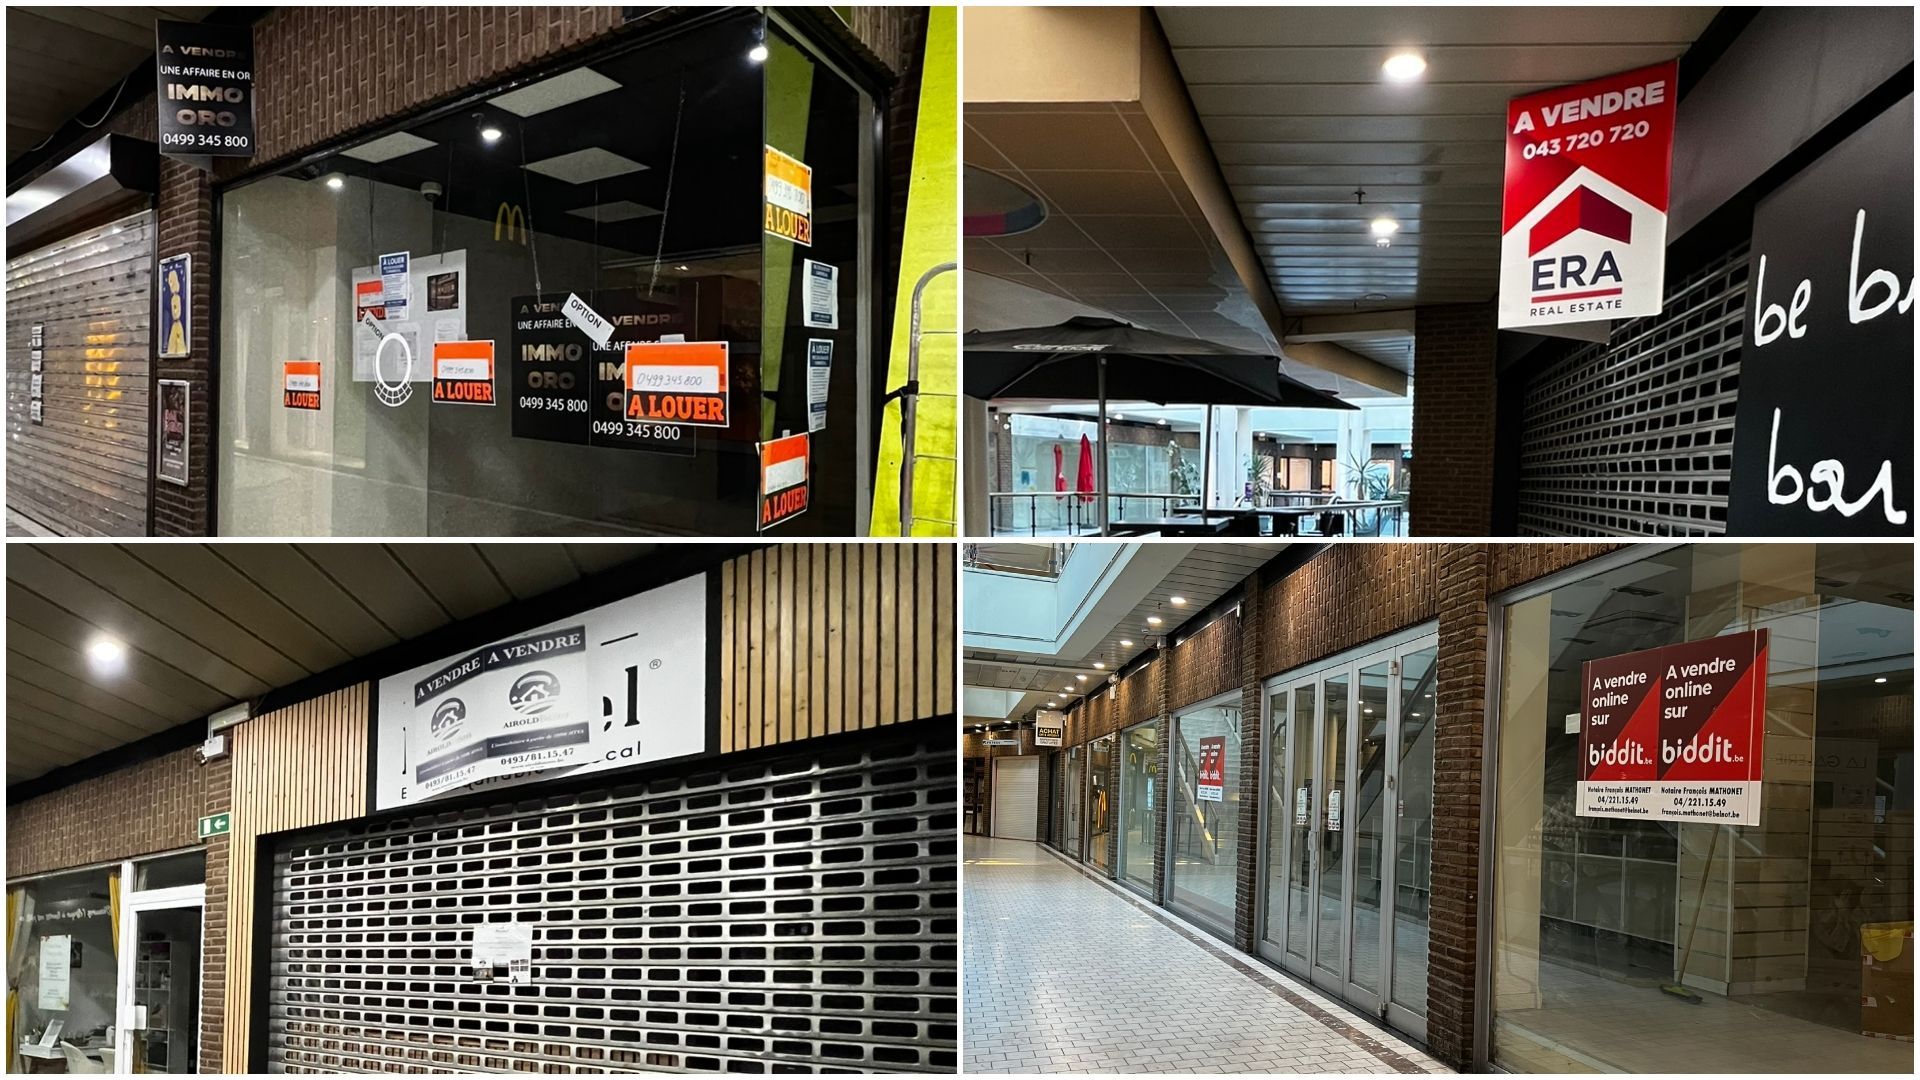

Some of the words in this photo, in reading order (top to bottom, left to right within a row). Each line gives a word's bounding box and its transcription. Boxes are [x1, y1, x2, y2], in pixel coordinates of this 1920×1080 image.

[162, 45, 174, 54] A
[179, 46, 240, 58] VENDR
[160, 65, 181, 76] UNE
[182, 67, 221, 78] AFFAIRE
[222, 69, 235, 79] EN
[236, 71, 251, 81] OR
[167, 83, 244, 104] IMMO
[1512, 111, 1535, 134] A
[1541, 80, 1666, 127] VENDRE
[176, 109, 237, 127] ORO
[162, 133, 195, 145] 0499
[197, 134, 222, 147] 345
[224, 135, 249, 148] 800
[1522, 138, 1561, 160] 043
[1566, 130, 1604, 152] 720
[1609, 121, 1650, 143] 720
[765, 204, 775, 231] A
[775, 207, 811, 244] LOUER
[1531, 250, 1623, 292] ERA
[520, 305, 530, 314] A
[1530, 305, 1563, 317] REAL
[1569, 300, 1622, 313] ESTATE
[1754, 254, 1811, 347] be
[570, 300, 602, 328] OPTION
[517, 320, 532, 330] UNE
[533, 319, 564, 329] AFFAIRE
[522, 344, 582, 361] IMMO
[527, 371, 576, 389] ORO
[285, 392, 291, 406] A
[292, 392, 320, 408] LOUER
[435, 382, 445, 399] A
[446, 382, 493, 401] LOUER
[519, 396, 544, 410] 0499
[545, 398, 565, 411] 345
[567, 399, 588, 412] 800
[628, 394, 644, 416] A
[648, 395, 724, 421] LOUER
[593, 420, 623, 436] 0499
[626, 423, 650, 438] 345
[653, 425, 681, 441] 800
[762, 499, 771, 523] A
[773, 485, 807, 520] LOUER
[487, 651, 500, 664] A
[503, 633, 581, 660] VENDRE
[1666, 665, 1678, 680] A
[1680, 657, 1736, 677] vendre
[417, 687, 425, 699] A
[426, 657, 481, 692] VENDRE
[1593, 677, 1602, 691] A
[1603, 671, 1647, 688] vendre
[1665, 681, 1712, 699] online
[1592, 691, 1629, 708] online
[1591, 713, 1610, 726] sur
[1664, 705, 1688, 719] sur
[500, 747, 574, 766] 0493/81.15.47
[1661, 731, 1744, 764] biddit.be
[1661, 787, 1681, 795] Notaire
[1709, 787, 1743, 796] MATHONET
[1673, 797, 1727, 808] 04/221.15.49
